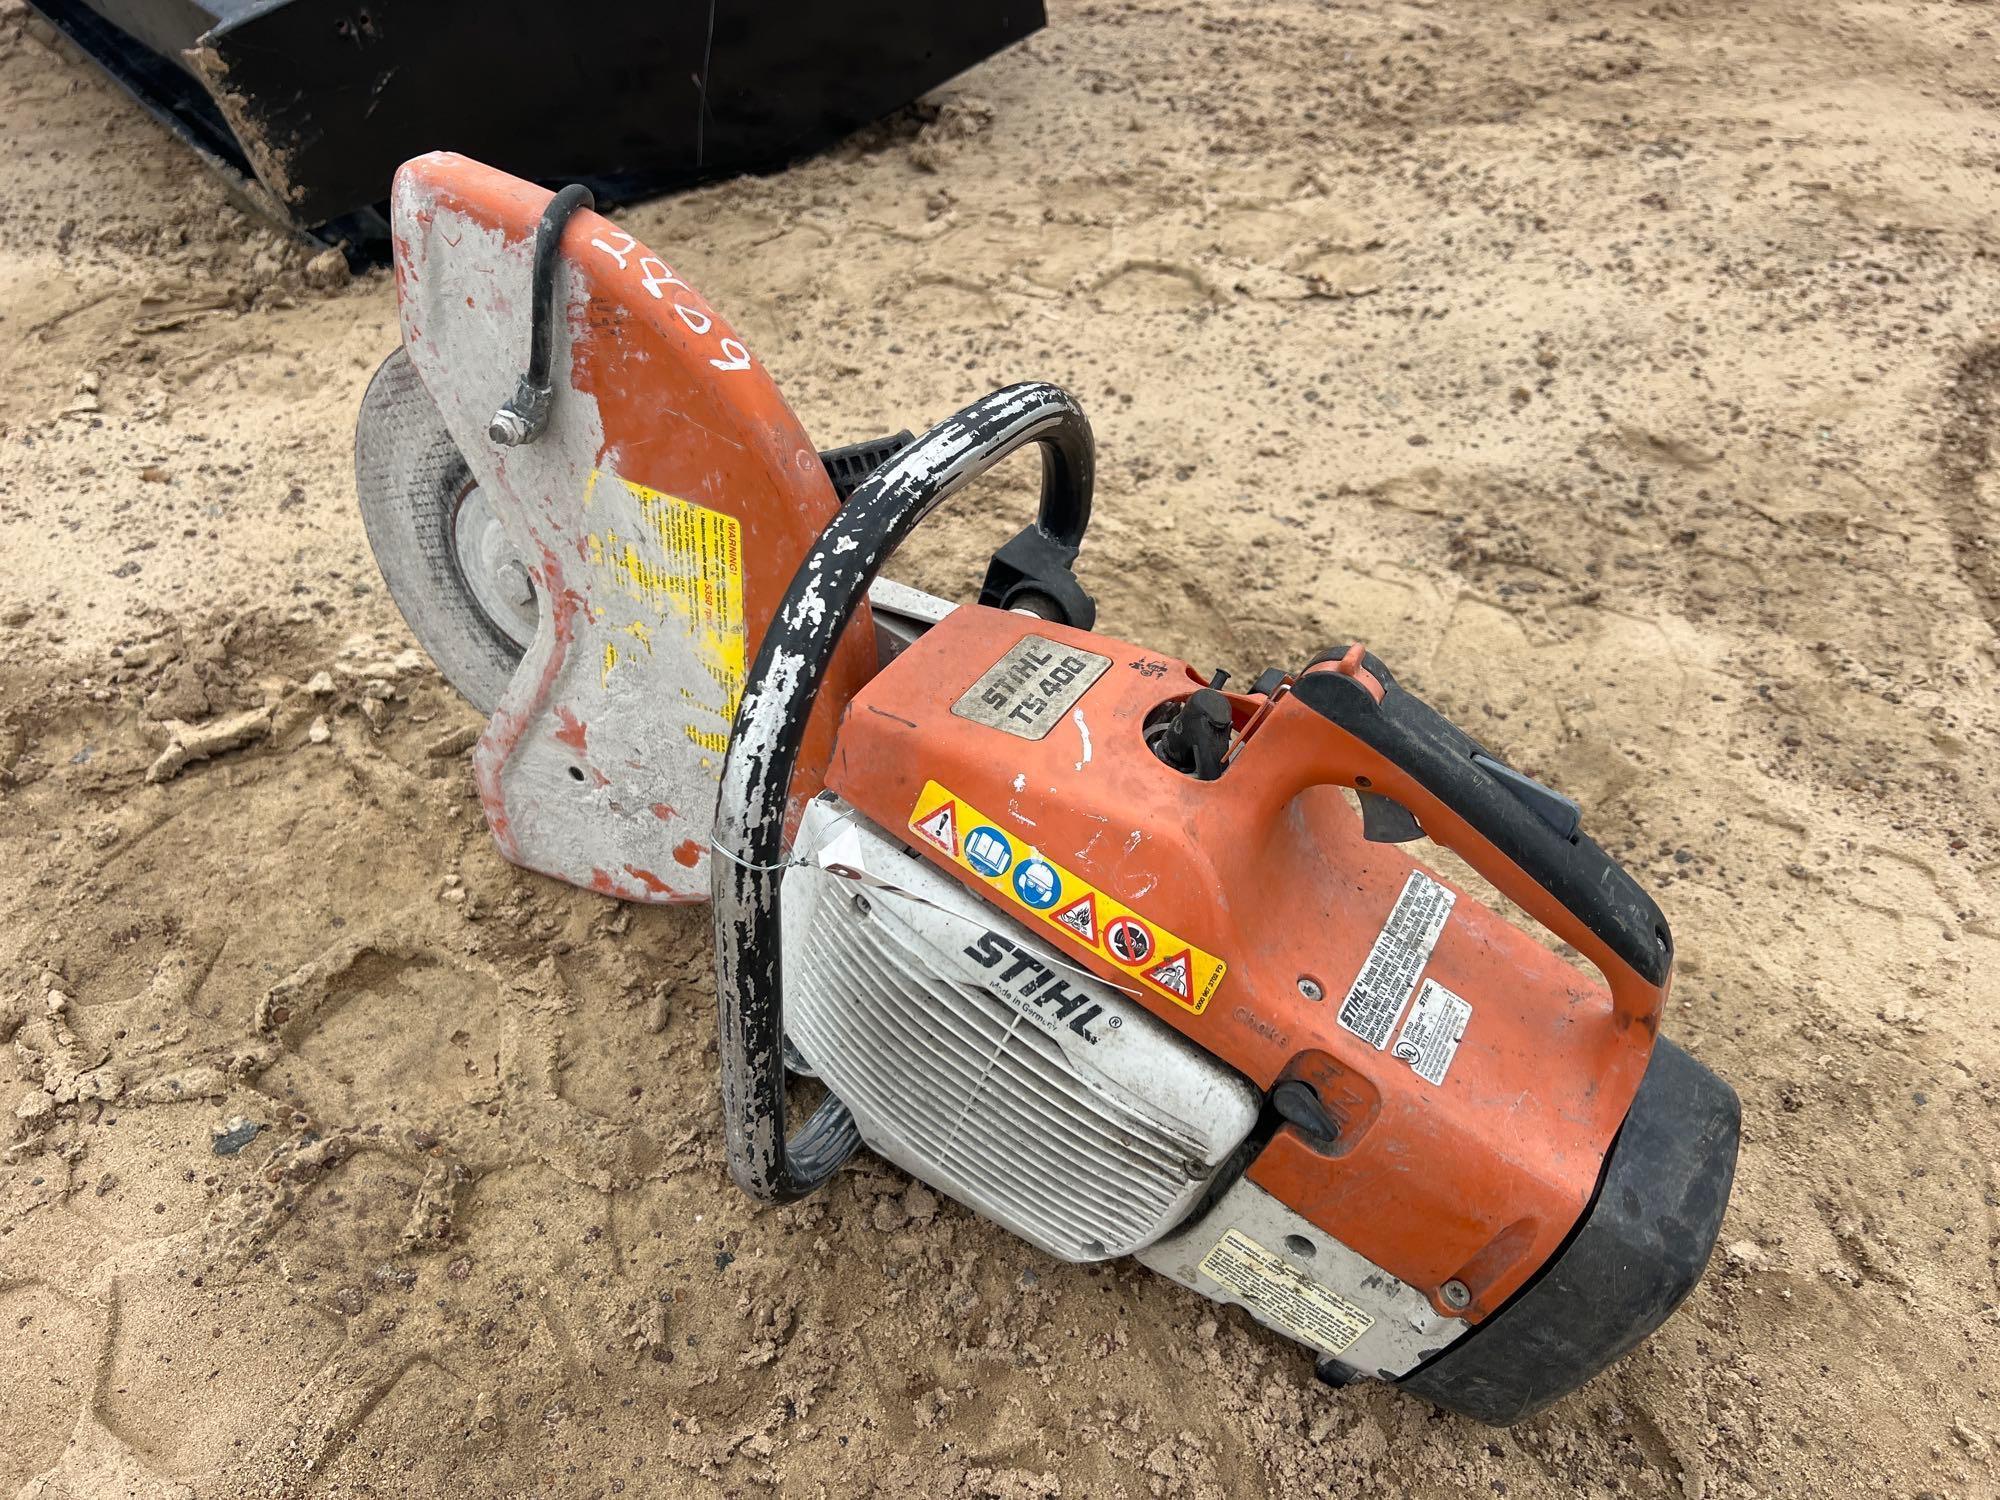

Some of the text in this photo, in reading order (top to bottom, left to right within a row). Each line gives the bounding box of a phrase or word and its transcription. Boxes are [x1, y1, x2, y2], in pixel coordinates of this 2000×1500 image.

[591, 231, 751, 370] 2809
[726, 520, 737, 575] WARNING!
[703, 582, 713, 606] 5350
[981, 652, 1052, 710] STIHL
[1008, 656, 1086, 724] TS 400
[1369, 952, 1384, 968] Stihl
[1375, 944, 1388, 957] AG
[1359, 963, 1378, 987] Andreas
[1382, 975, 1392, 987] EPA
[1386, 962, 1399, 978] PHASE
[963, 931, 1103, 1045] STIHL
[1389, 973, 1413, 1012] ADJUSTMENT AND
[1013, 997, 1021, 1007] in
[1195, 997, 1205, 1010] 0000
[1338, 984, 1368, 1028] STIHL
[1364, 1012, 1384, 1042] COMPLIANCE
[1386, 974, 1403, 998] CATEGORY
[1233, 1004, 1289, 1049] Choke
[1350, 1011, 1365, 1032] ENGINE
[1362, 1007, 1376, 1026] ENGINE
[1357, 1023, 1368, 1036] THIS
[1223, 1238, 1242, 1251] cause
[1241, 1249, 1264, 1265] serious
[1226, 1234, 1261, 1258] precautions
[1317, 1293, 1344, 1311] improper
[1355, 1317, 1369, 1326] can
[1352, 1310, 1372, 1323] safety
